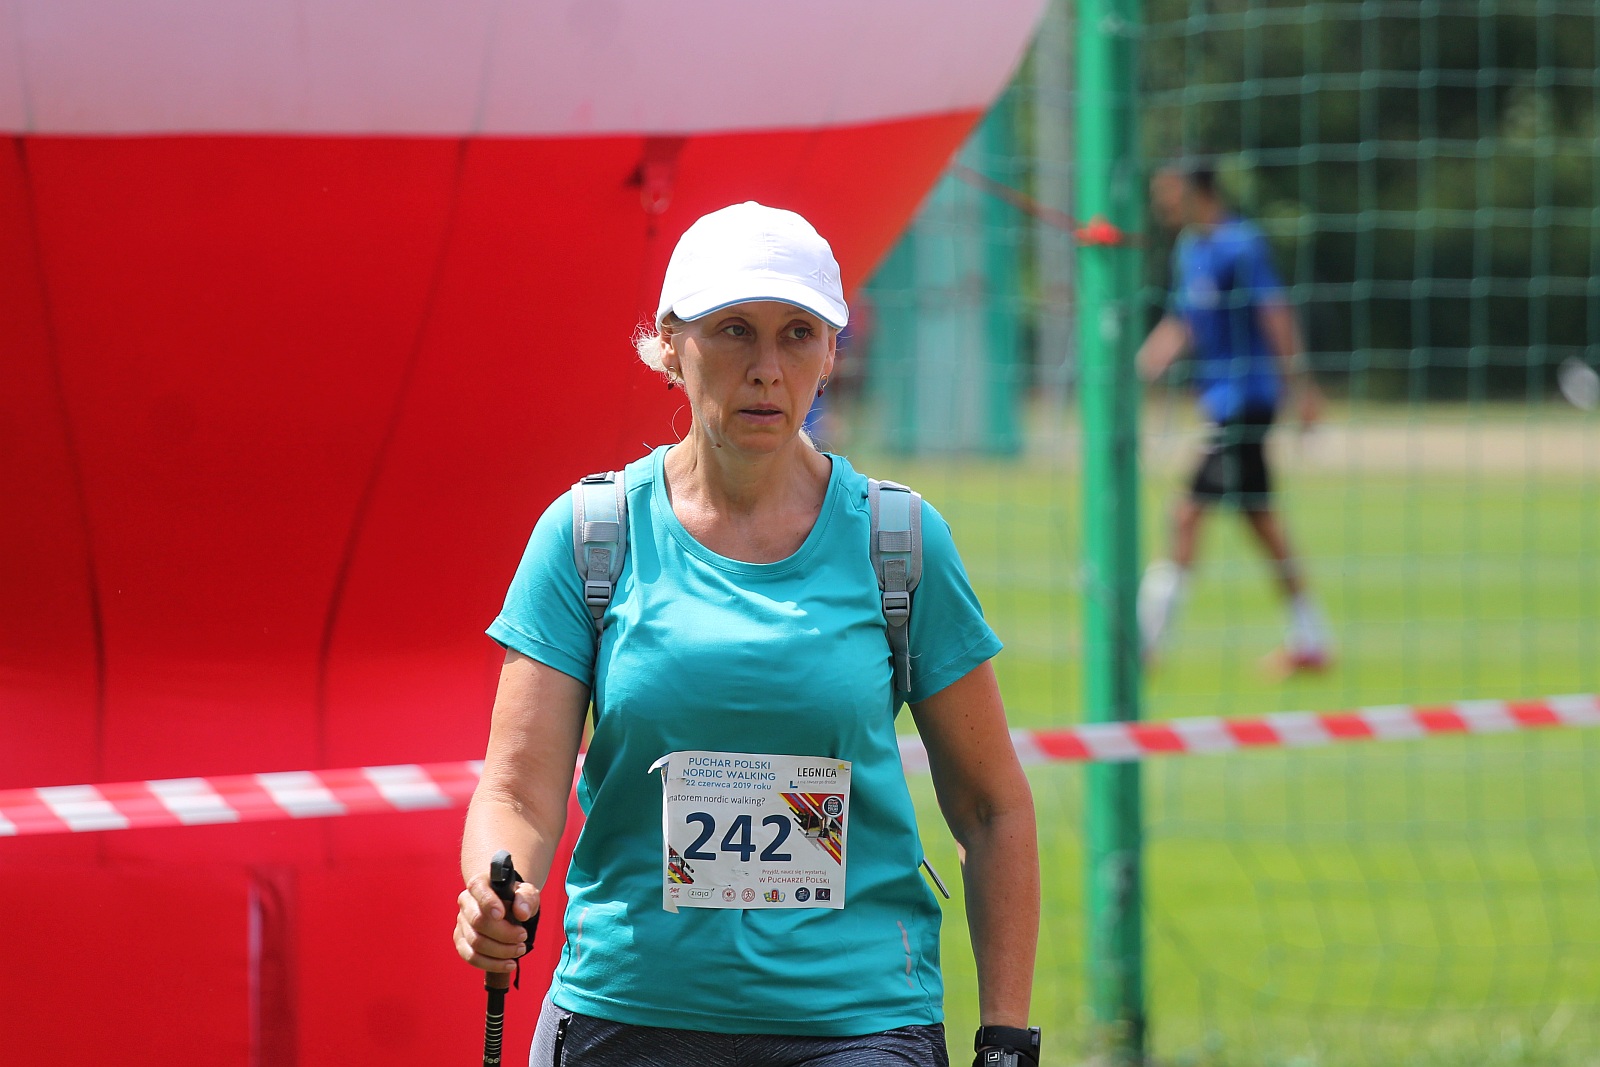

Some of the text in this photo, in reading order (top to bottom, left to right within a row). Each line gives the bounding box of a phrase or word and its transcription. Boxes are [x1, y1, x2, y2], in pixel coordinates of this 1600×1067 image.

[688, 757, 771, 770] PUCHAR POLSKI
[682, 768, 776, 781] NORDIC WALKING
[797, 767, 837, 778] LEGNICA
[685, 779, 696, 787] 22
[732, 781, 752, 789] 2019
[753, 782, 772, 790] roku
[703, 795, 729, 804] nordic
[730, 796, 766, 807] walking?
[683, 811, 792, 863] 242
[767, 876, 803, 884] PUCHARZE
[805, 876, 830, 884] POLSKI
